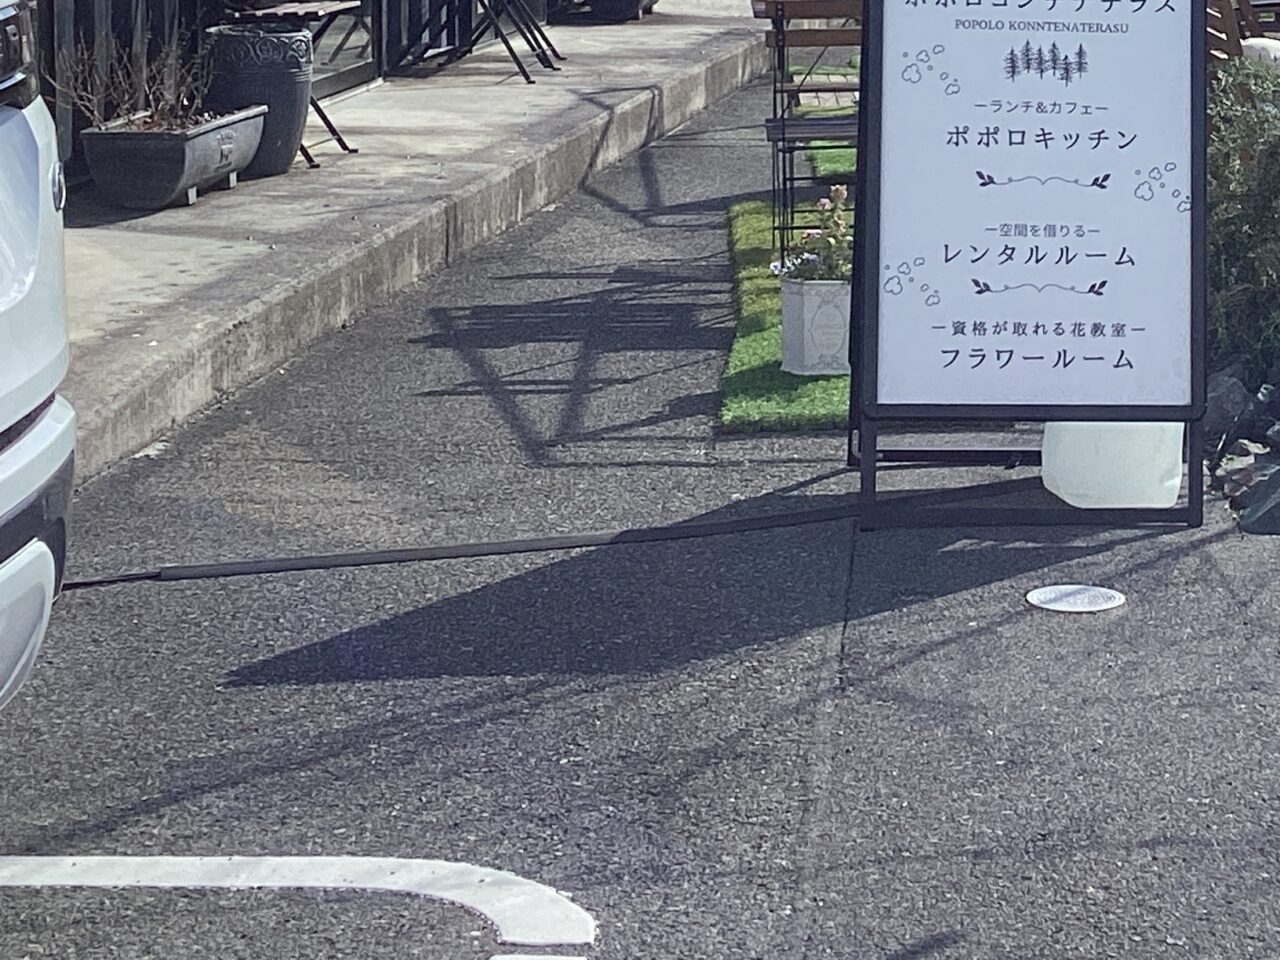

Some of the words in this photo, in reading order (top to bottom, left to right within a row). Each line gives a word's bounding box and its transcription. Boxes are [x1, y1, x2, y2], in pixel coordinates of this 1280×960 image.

[954, 19, 1005, 31] POPOLO
[1008, 20, 1130, 34] KONNTENATERASU
[946, 125, 1139, 151] ポポロキッチン
[942, 243, 1136, 267] レンタルルーム
[940, 348, 1135, 370] フラワールーム
